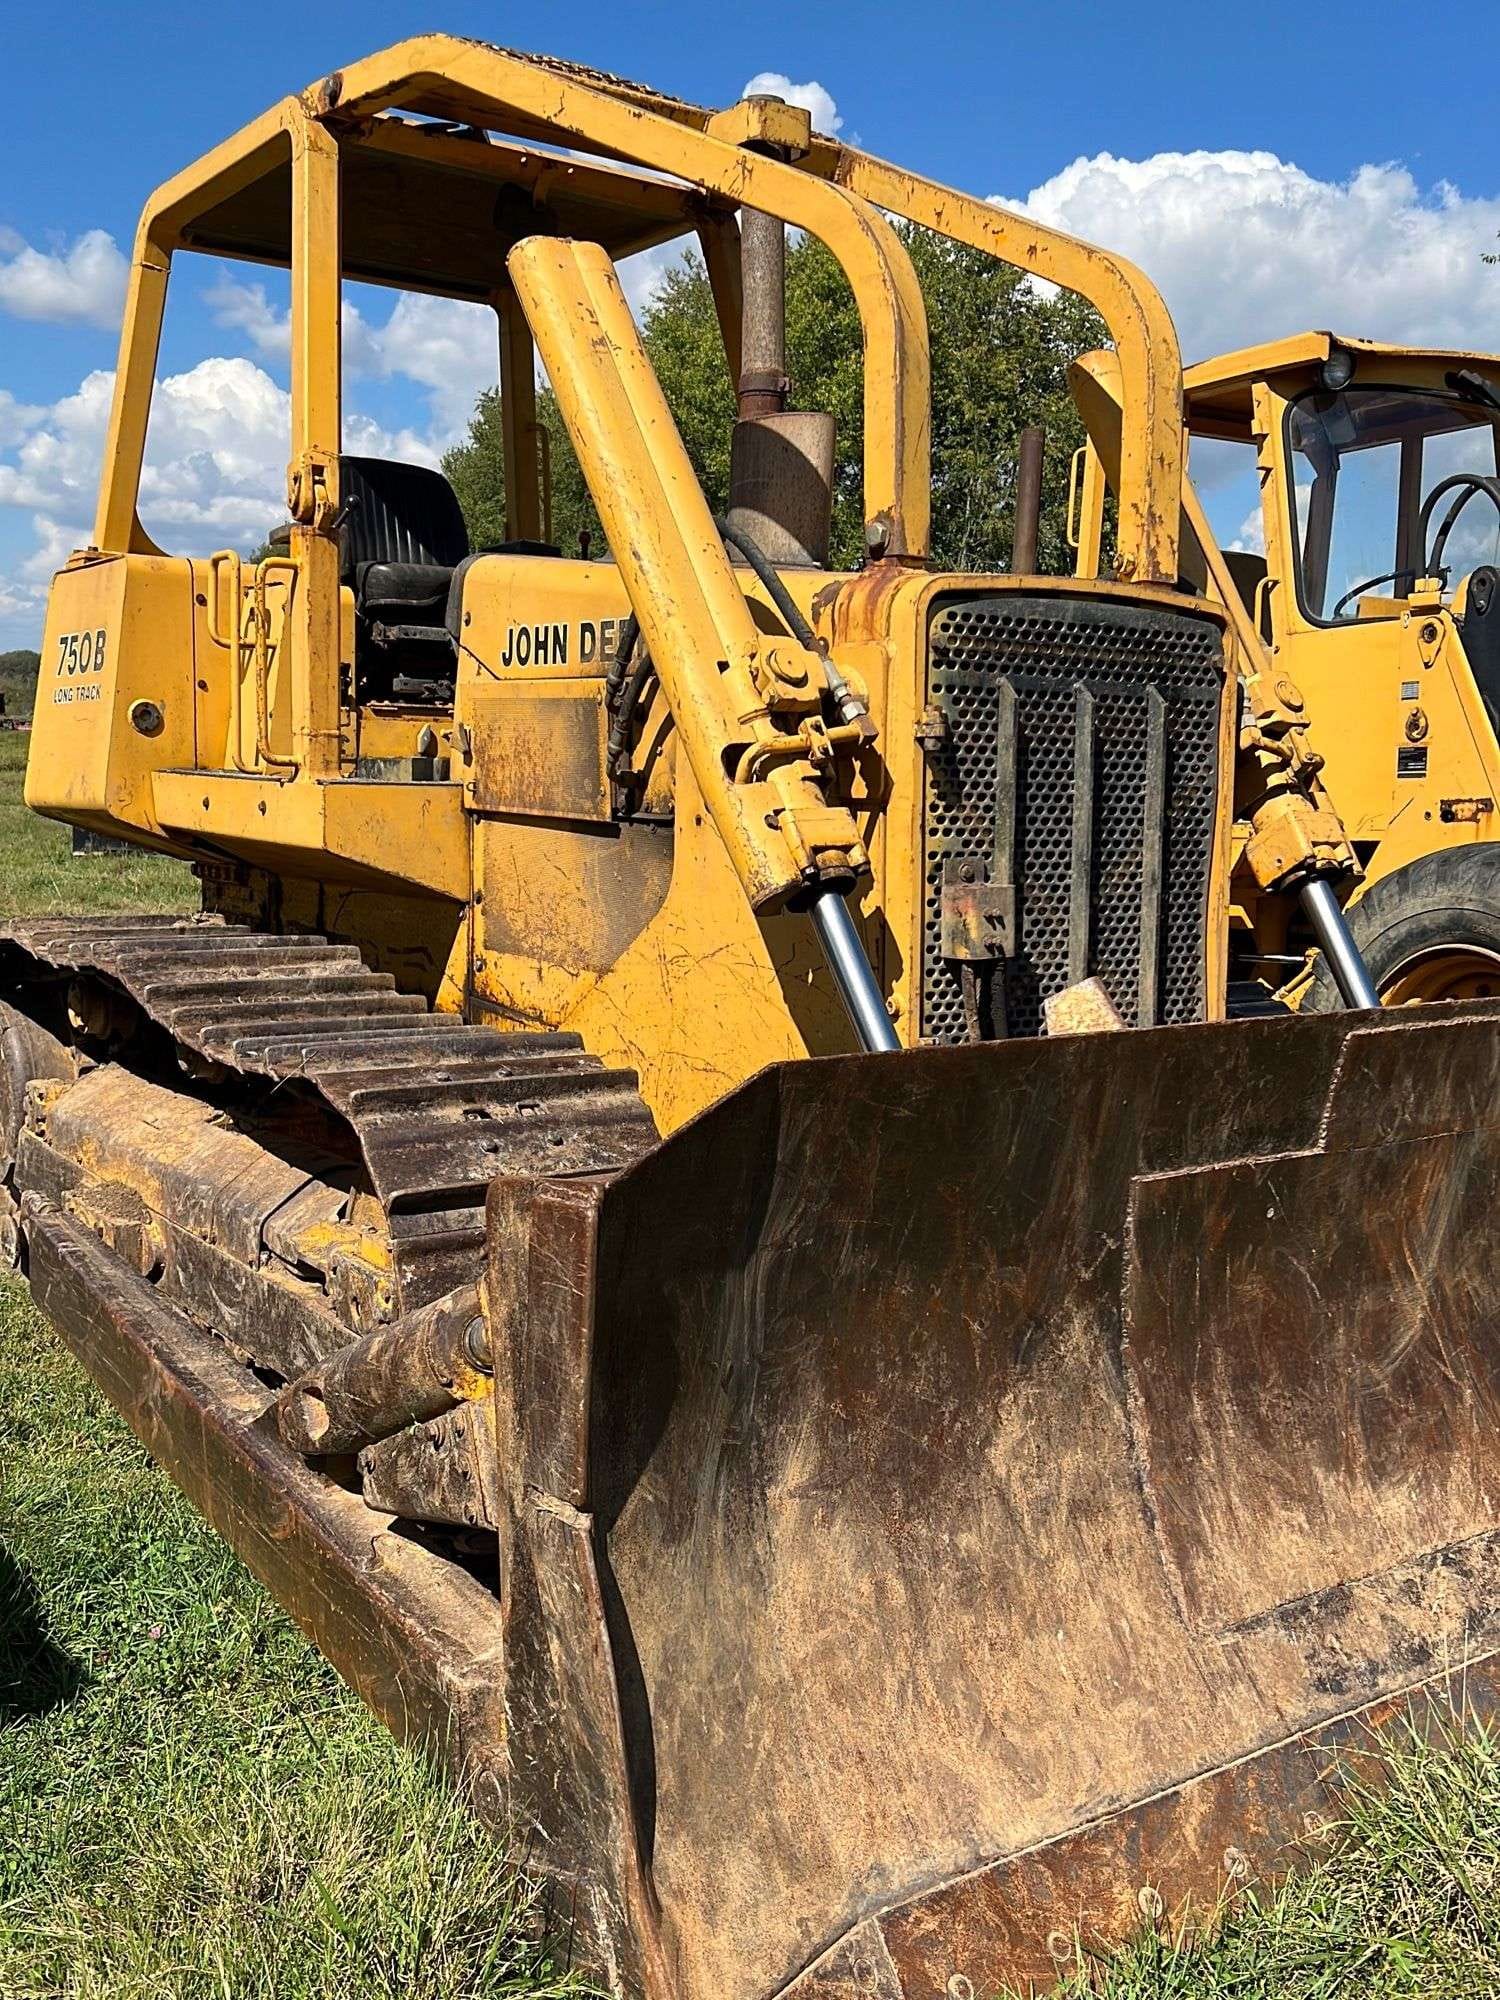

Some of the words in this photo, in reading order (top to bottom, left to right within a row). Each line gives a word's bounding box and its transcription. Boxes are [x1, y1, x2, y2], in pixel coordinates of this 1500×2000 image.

[57, 630, 106, 676] 750B
[502, 623, 568, 667] JOHN
[54, 688, 73, 703] LONG
[76, 685, 102, 701] TRACK
